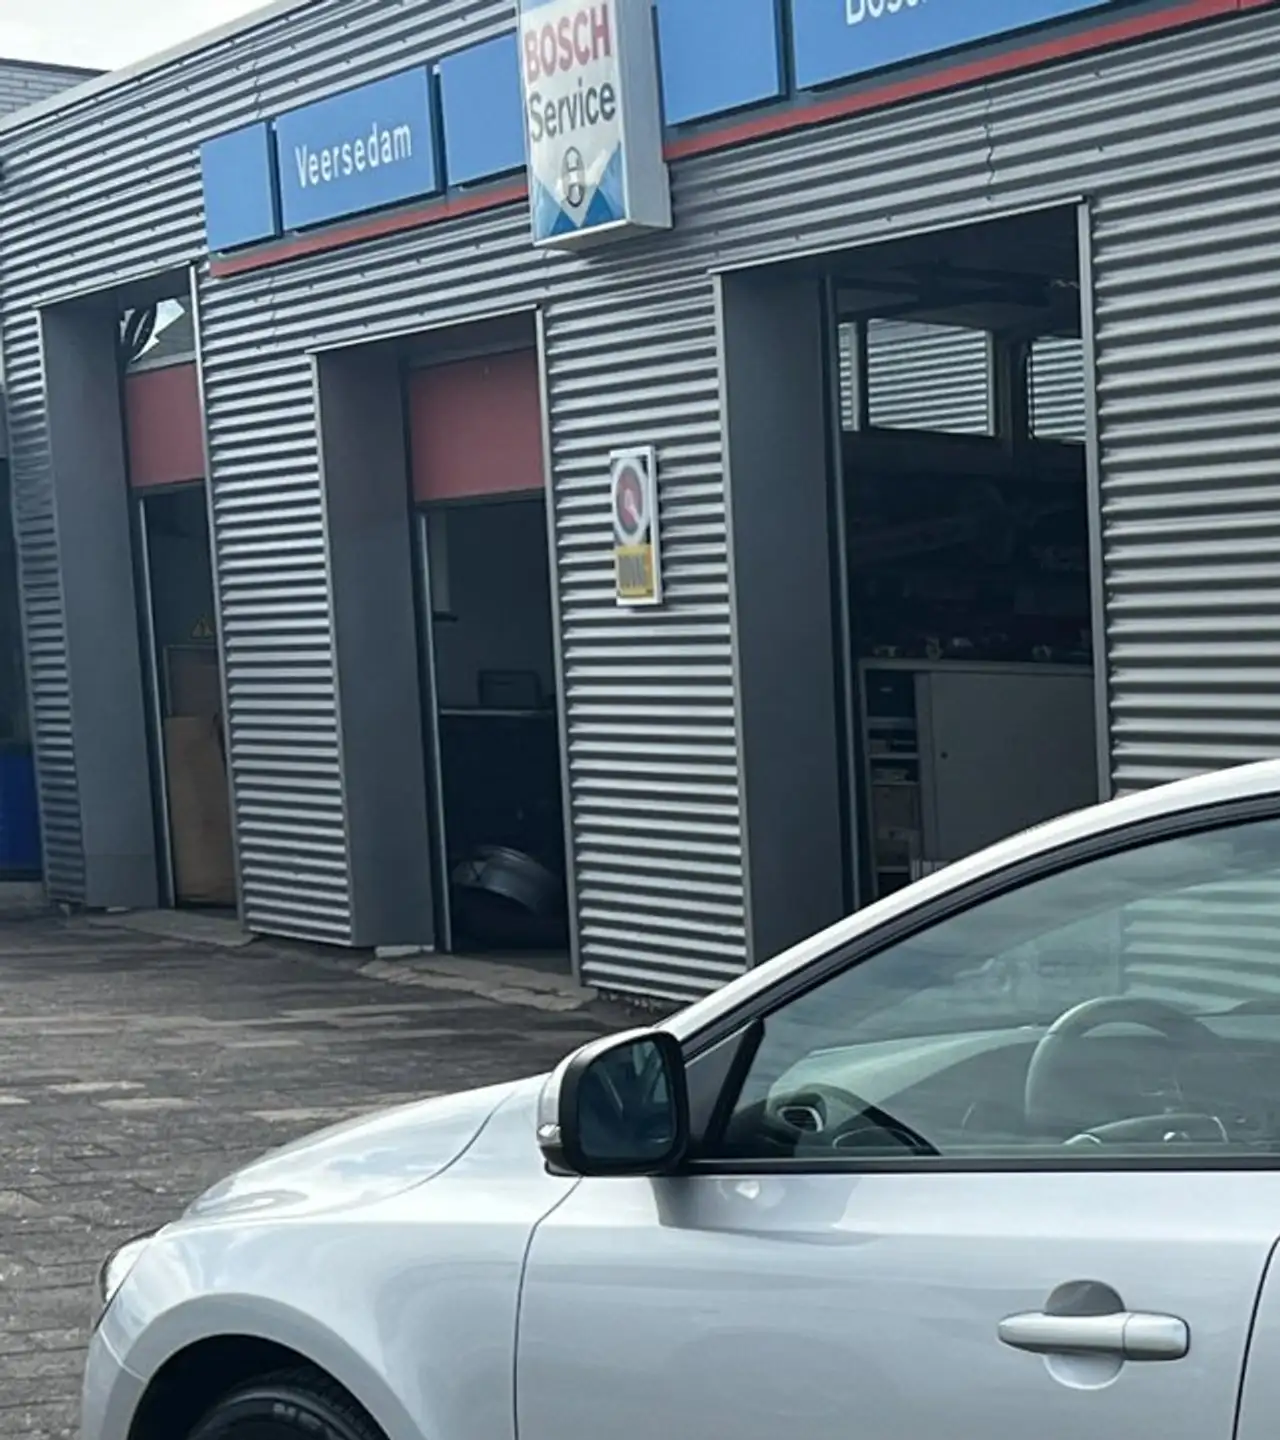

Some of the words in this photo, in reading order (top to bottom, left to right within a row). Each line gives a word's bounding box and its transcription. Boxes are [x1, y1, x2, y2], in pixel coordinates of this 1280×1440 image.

[524, 4, 611, 83] BOSCH
[529, 77, 616, 143] Service
[294, 121, 412, 188] Veersedam
